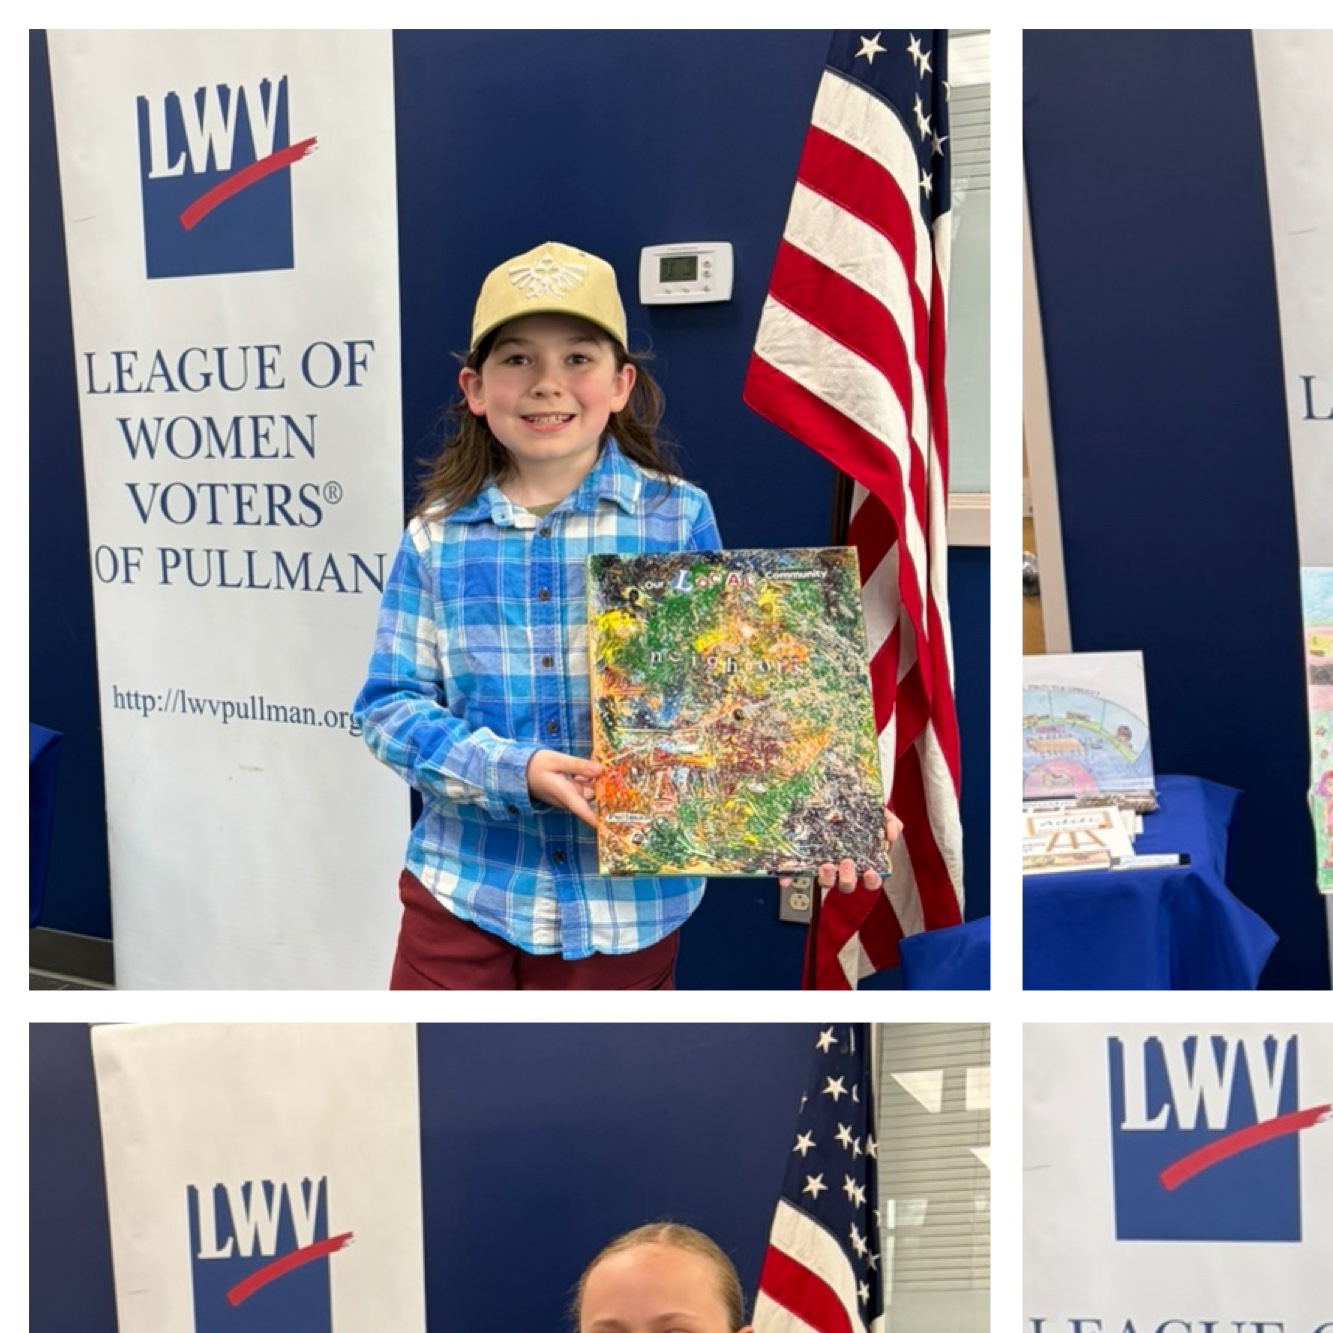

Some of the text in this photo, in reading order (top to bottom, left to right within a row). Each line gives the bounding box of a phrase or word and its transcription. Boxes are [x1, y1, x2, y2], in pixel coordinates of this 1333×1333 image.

[138, 75, 288, 179] LWV
[86, 340, 374, 394] LEAGUE OF
[117, 415, 317, 459] WOMEN
[92, 546, 384, 593] OF PULLMAN
[763, 569, 828, 580] Community
[1114, 1034, 1297, 1131] LWV
[188, 1177, 327, 1260] LWV
